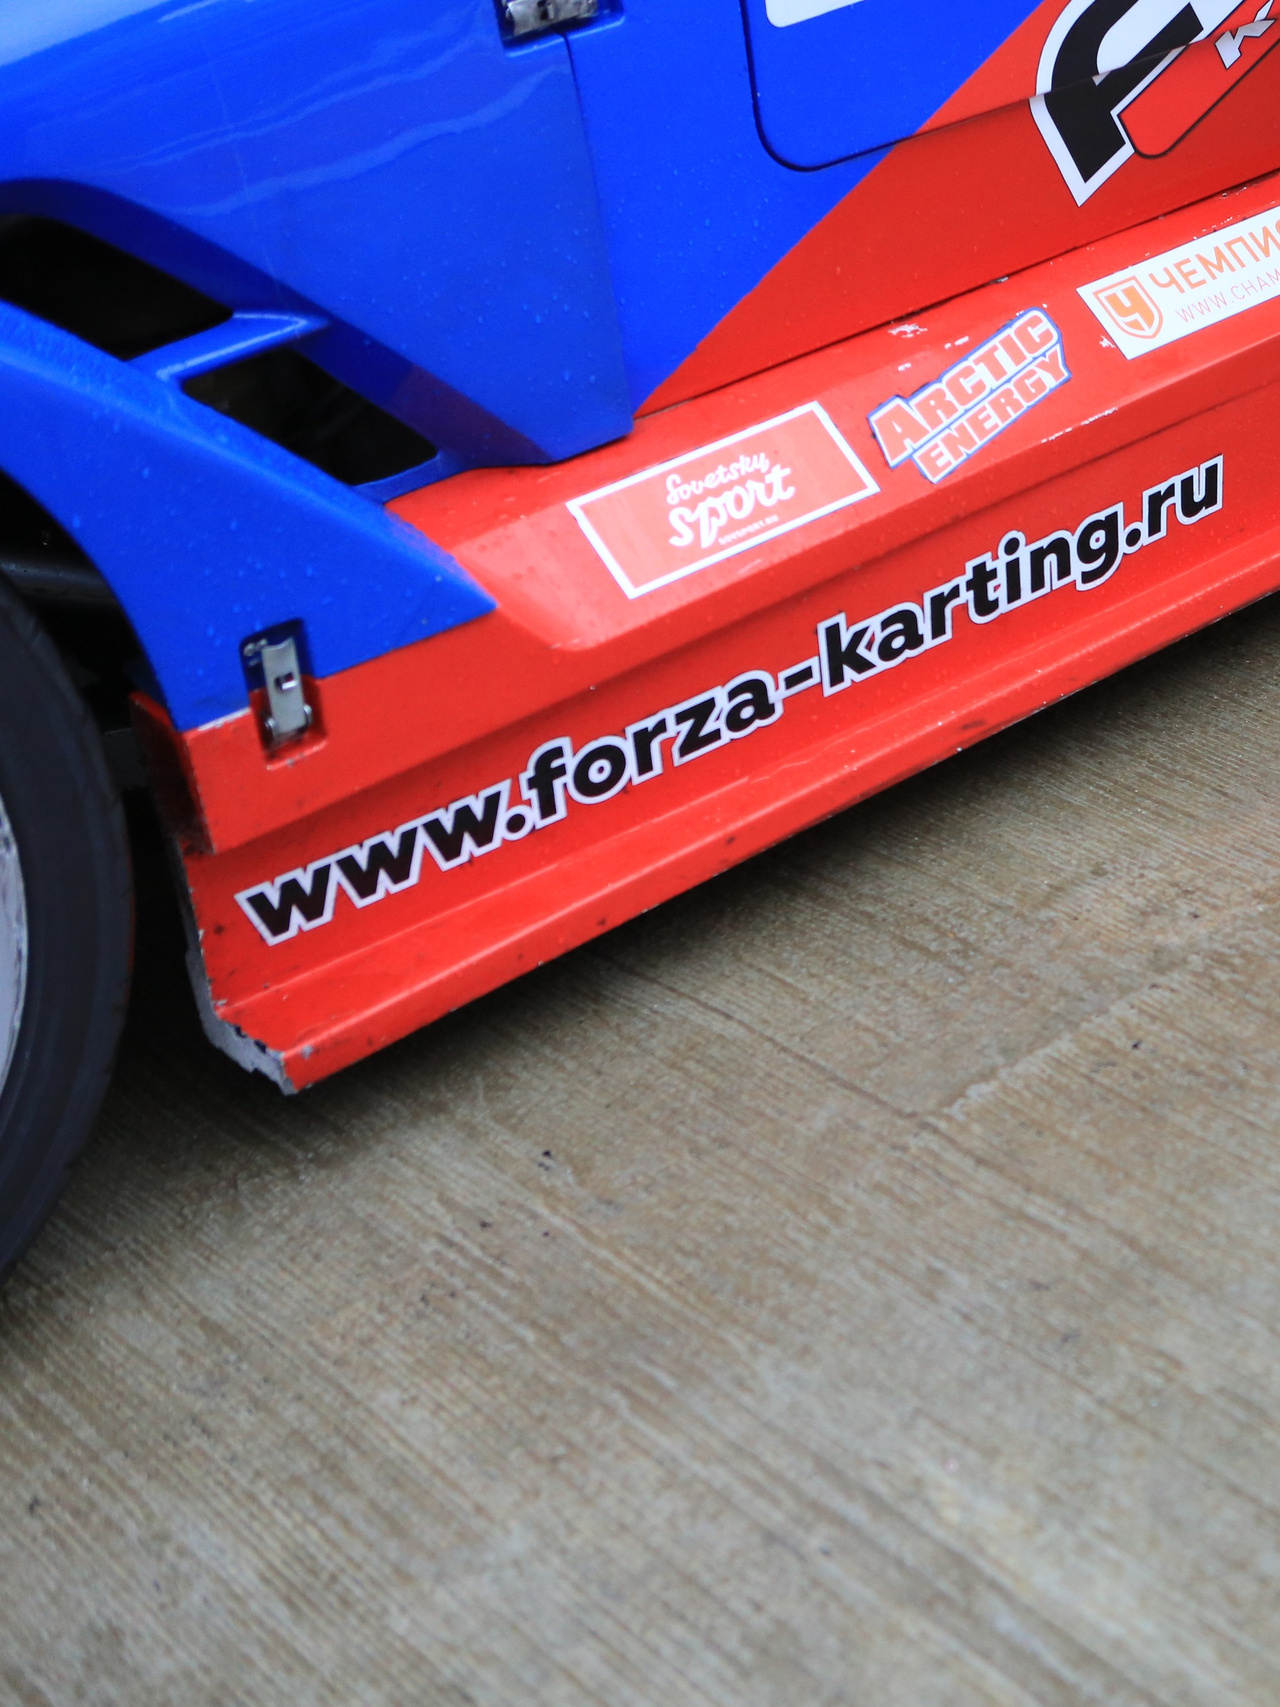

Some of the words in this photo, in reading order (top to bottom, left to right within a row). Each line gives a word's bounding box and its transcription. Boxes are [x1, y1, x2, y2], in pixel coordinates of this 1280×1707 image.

[871, 312, 1056, 464] ARCTIC
[914, 349, 1068, 480] ENERGY
[665, 452, 770, 505] Sovetsky
[238, 458, 1222, 942] www.forza-karting.ru
